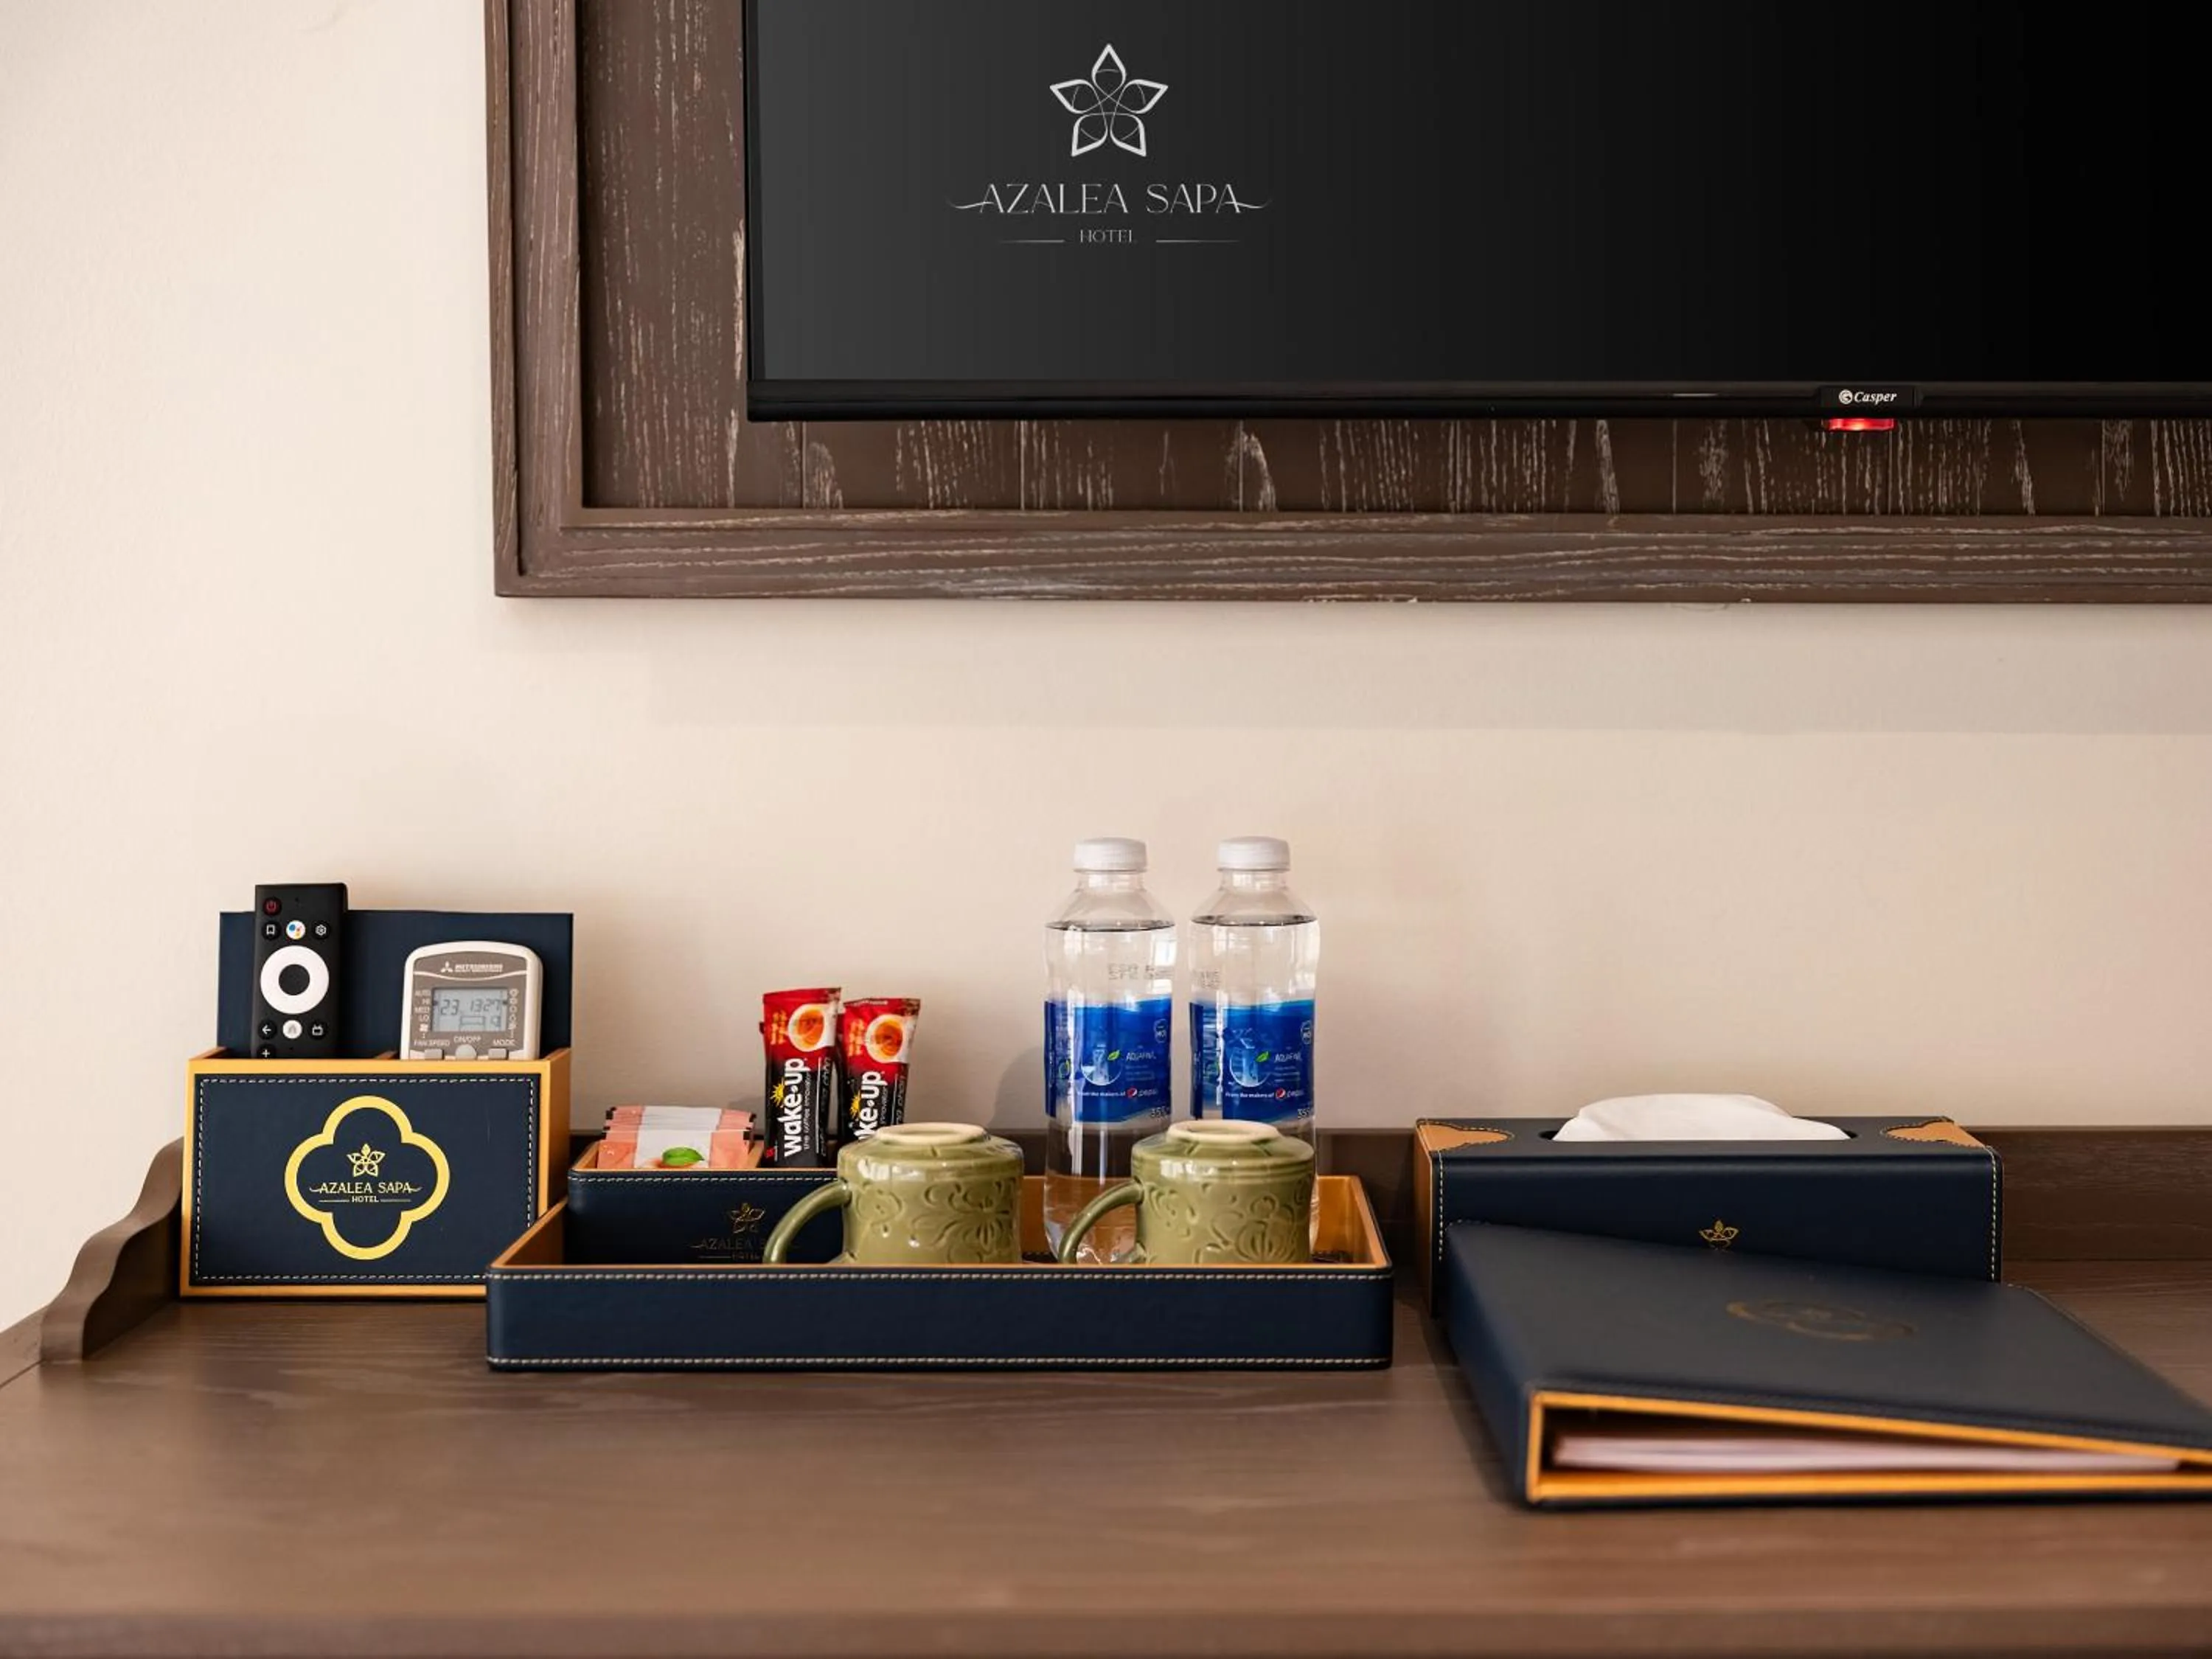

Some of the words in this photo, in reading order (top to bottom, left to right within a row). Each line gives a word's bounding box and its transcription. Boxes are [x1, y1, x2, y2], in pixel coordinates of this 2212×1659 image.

[954, 183, 1129, 214] AZALEA
[1146, 183, 1268, 214] SAPA
[1079, 229, 1135, 245] HOTEL
[1854, 391, 1898, 406] Casper
[440, 999, 460, 1016] 23
[853, 1071, 888, 1140] ke-up
[310, 1182, 372, 1194] AZALEA
[378, 1181, 422, 1194] SAPA
[352, 1195, 380, 1203] HOTEL
